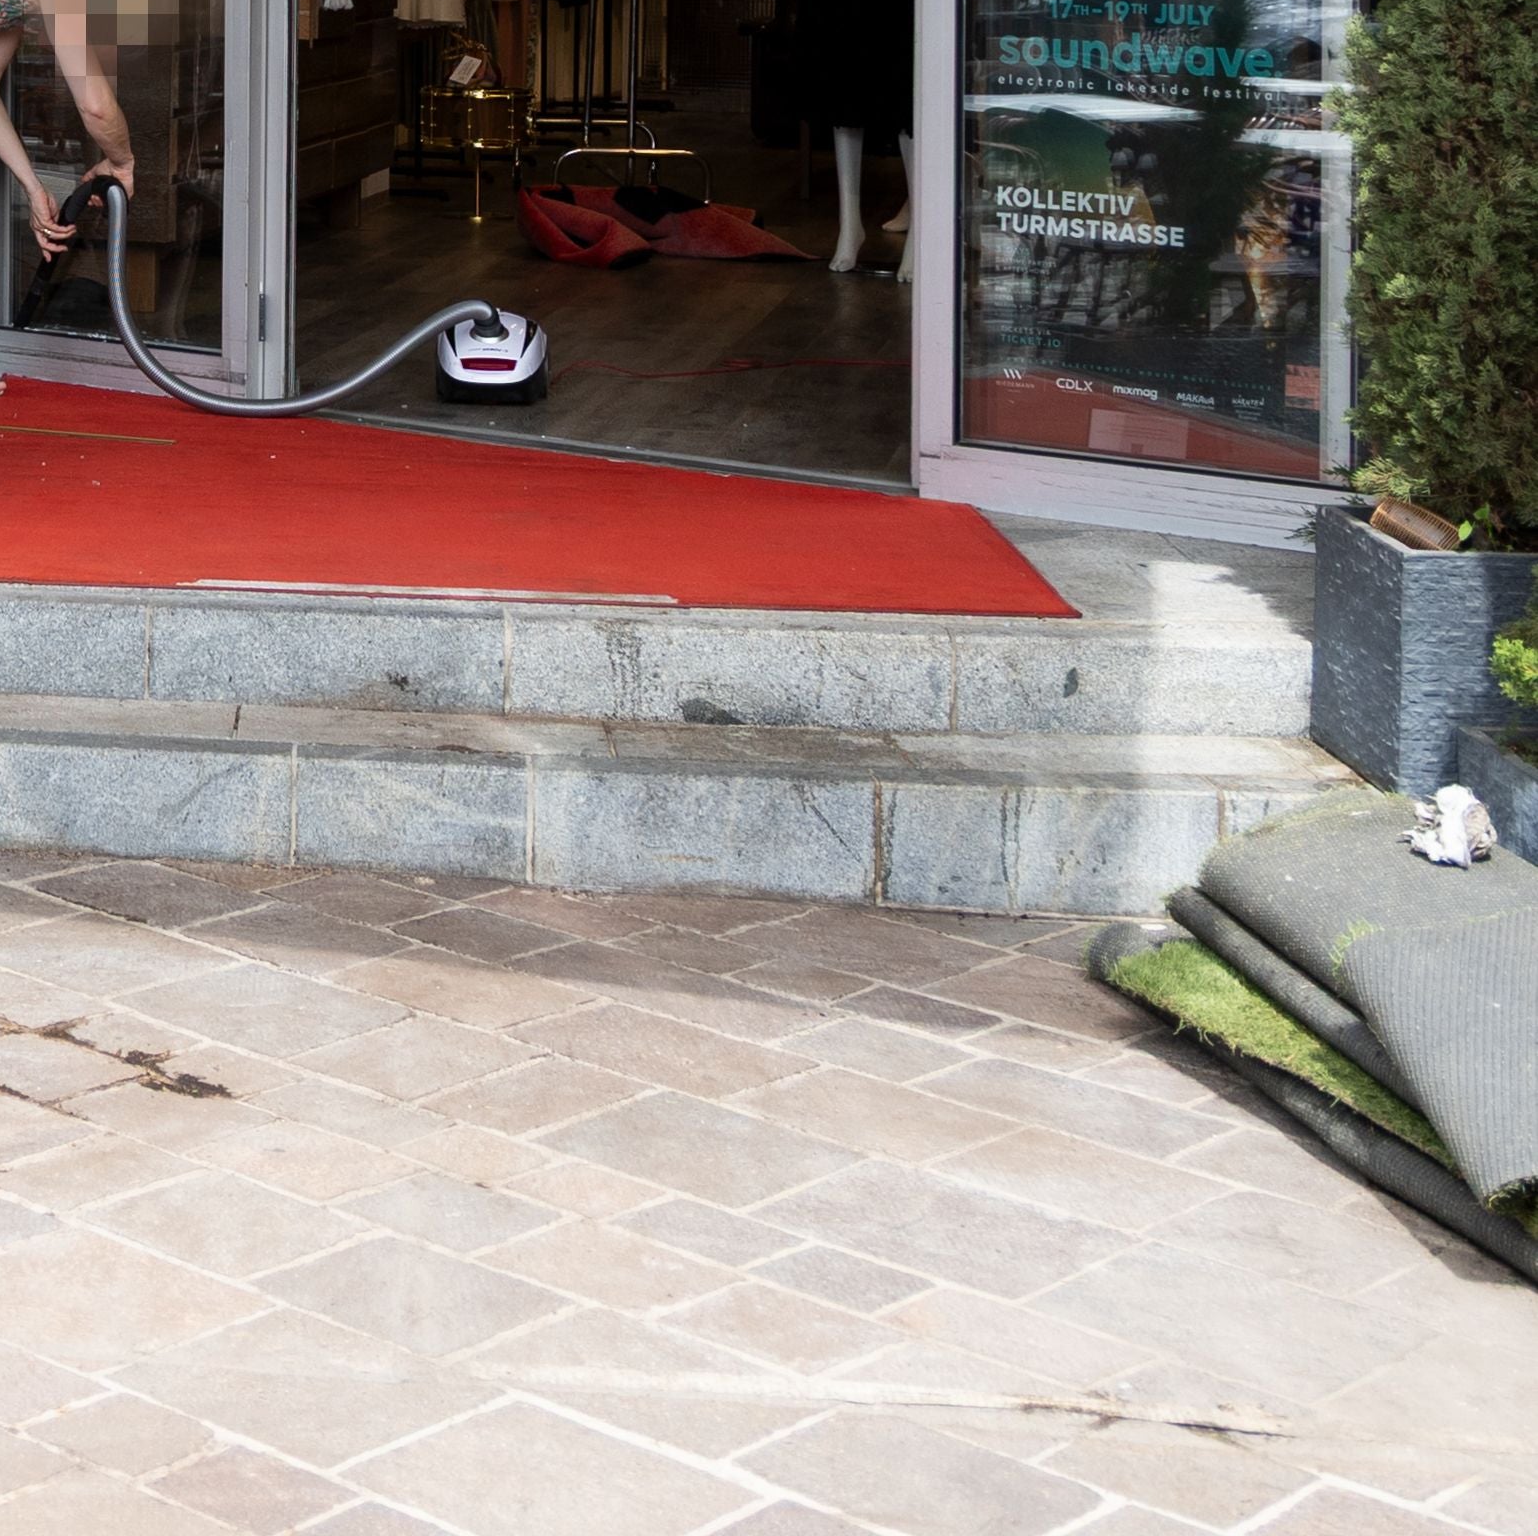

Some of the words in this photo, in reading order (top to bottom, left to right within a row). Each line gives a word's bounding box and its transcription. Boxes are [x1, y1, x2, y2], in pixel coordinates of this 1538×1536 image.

[1153, 2, 1216, 26] JULY
[997, 73, 1096, 91] electronic
[1106, 79, 1191, 97] lakeside
[1203, 85, 1281, 102] festival
[995, 185, 1136, 217] KOLLEKTIV
[995, 211, 1186, 248] TURMSTRASSE
[1055, 377, 1093, 393] CDLX
[1112, 385, 1158, 401] mixmag
